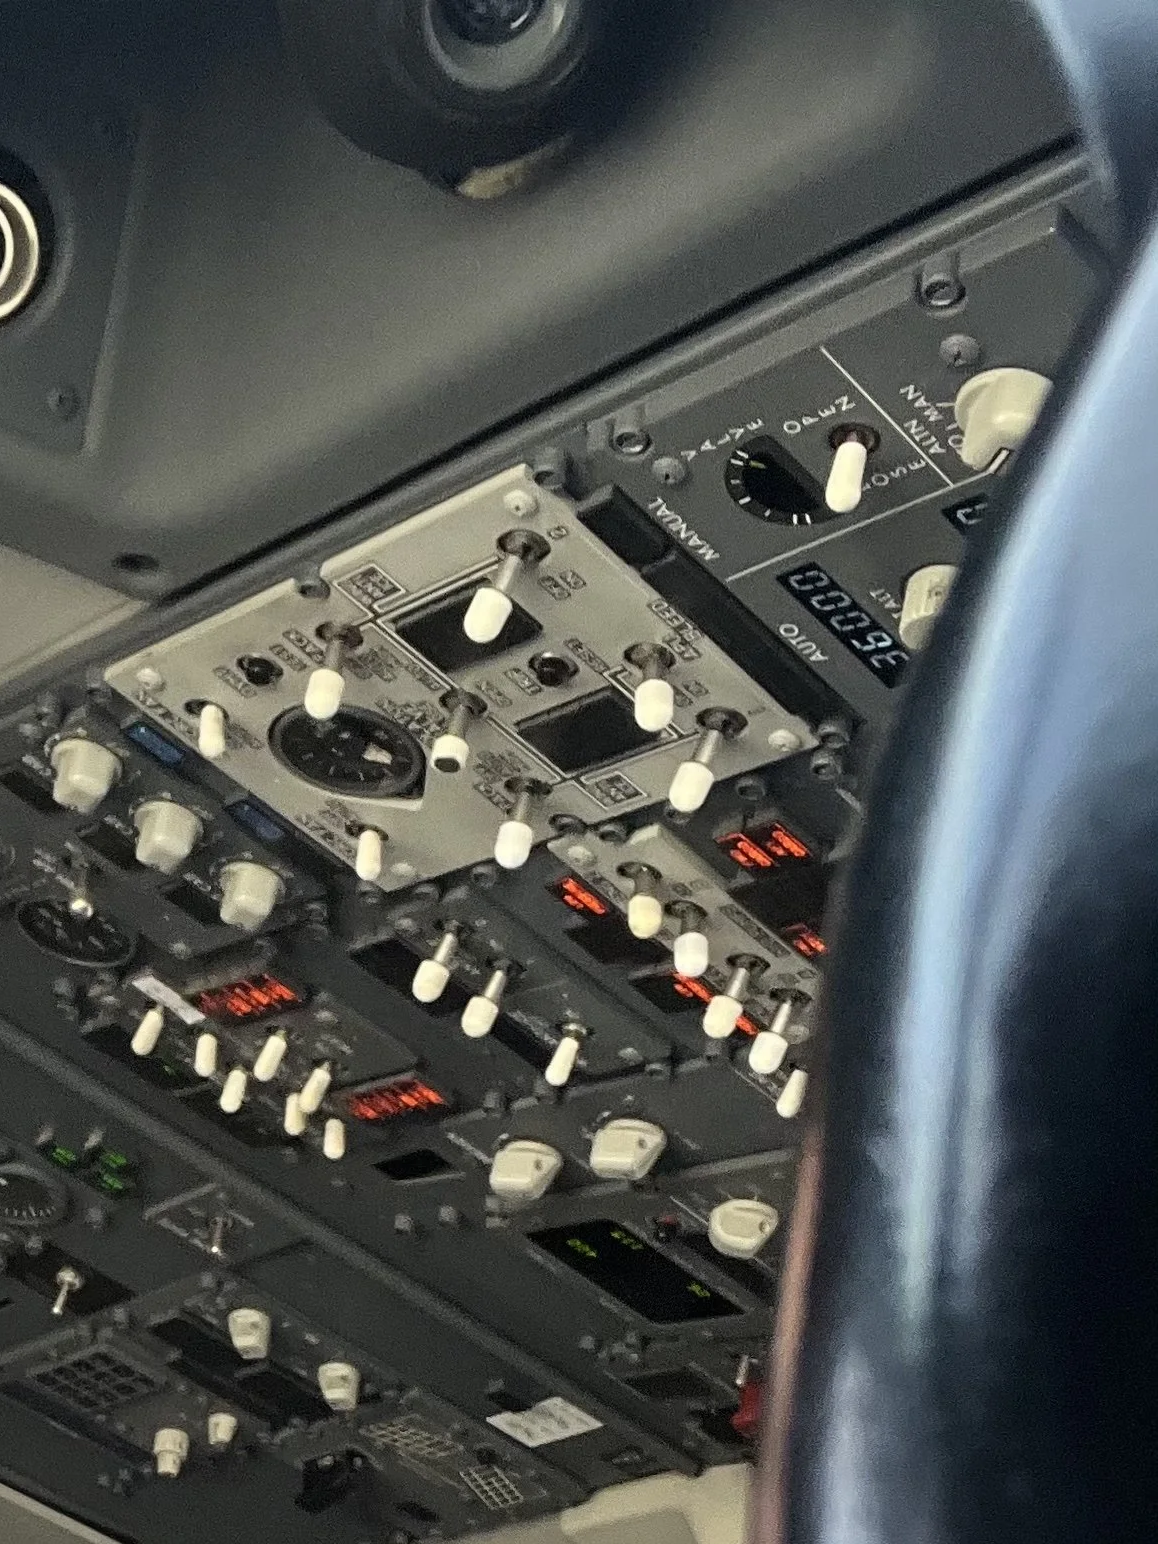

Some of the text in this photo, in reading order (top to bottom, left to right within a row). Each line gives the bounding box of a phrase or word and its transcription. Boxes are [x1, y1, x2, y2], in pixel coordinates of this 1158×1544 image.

[782, 395, 856, 434] OPEN
[899, 385, 943, 422] MAN
[680, 417, 764, 462] VALVE
[648, 497, 720, 562] MANUAL
[778, 622, 829, 664] AUTO
